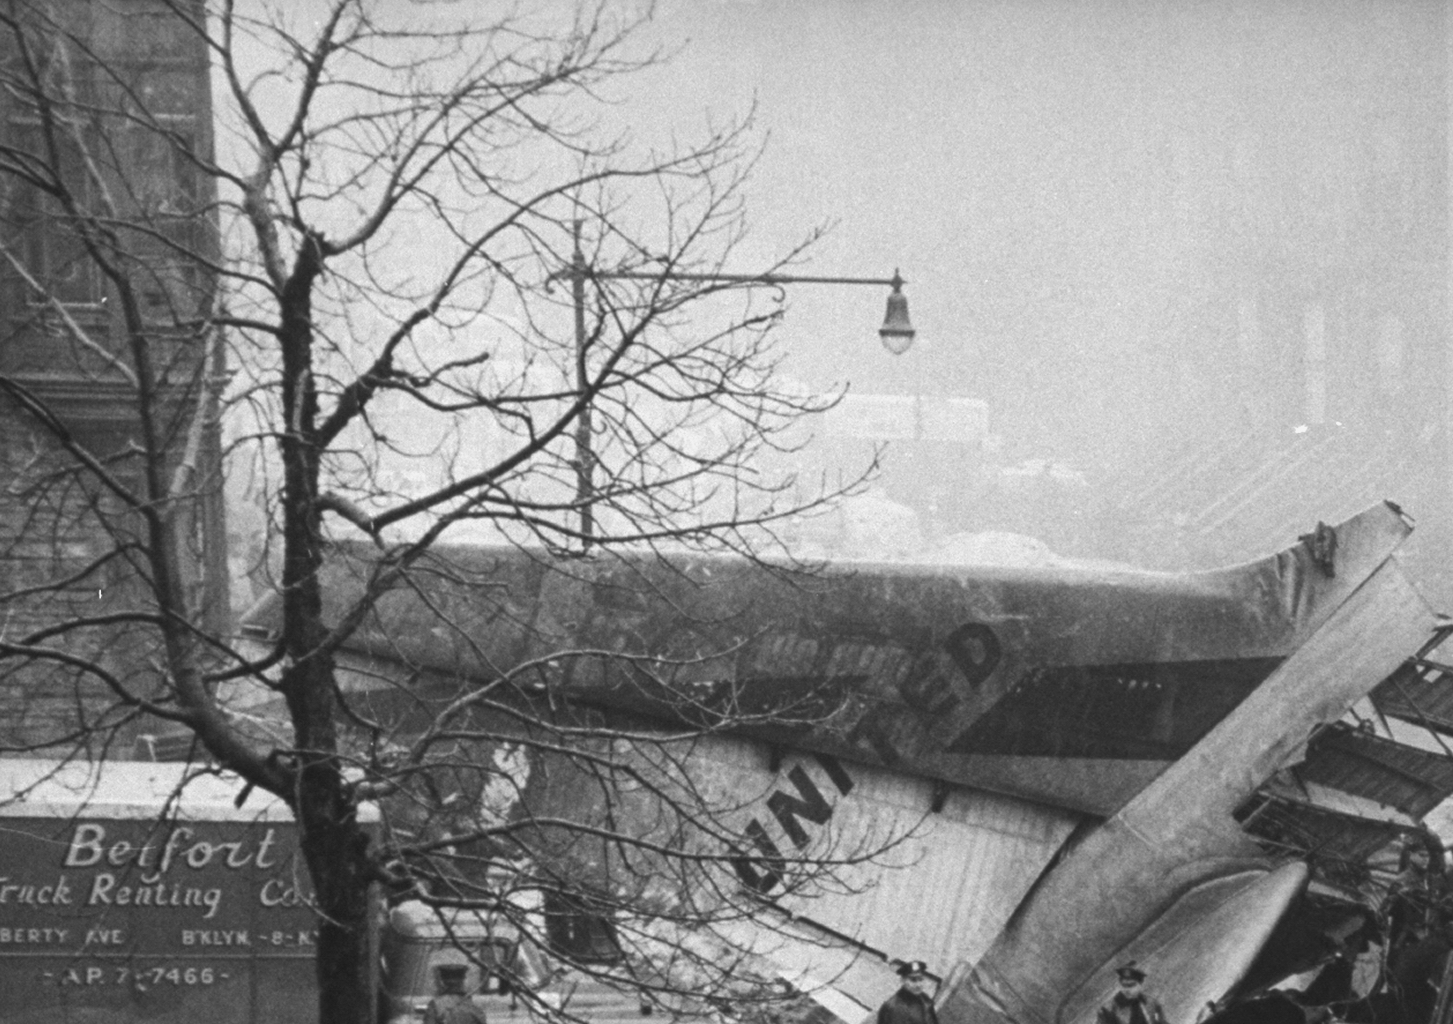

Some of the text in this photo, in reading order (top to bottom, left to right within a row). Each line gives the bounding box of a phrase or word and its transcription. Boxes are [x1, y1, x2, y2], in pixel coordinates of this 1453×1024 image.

[729, 622, 1001, 895] UNITED
[88, 872, 221, 919] Renting
[85, 929, 123, 945] AVE
